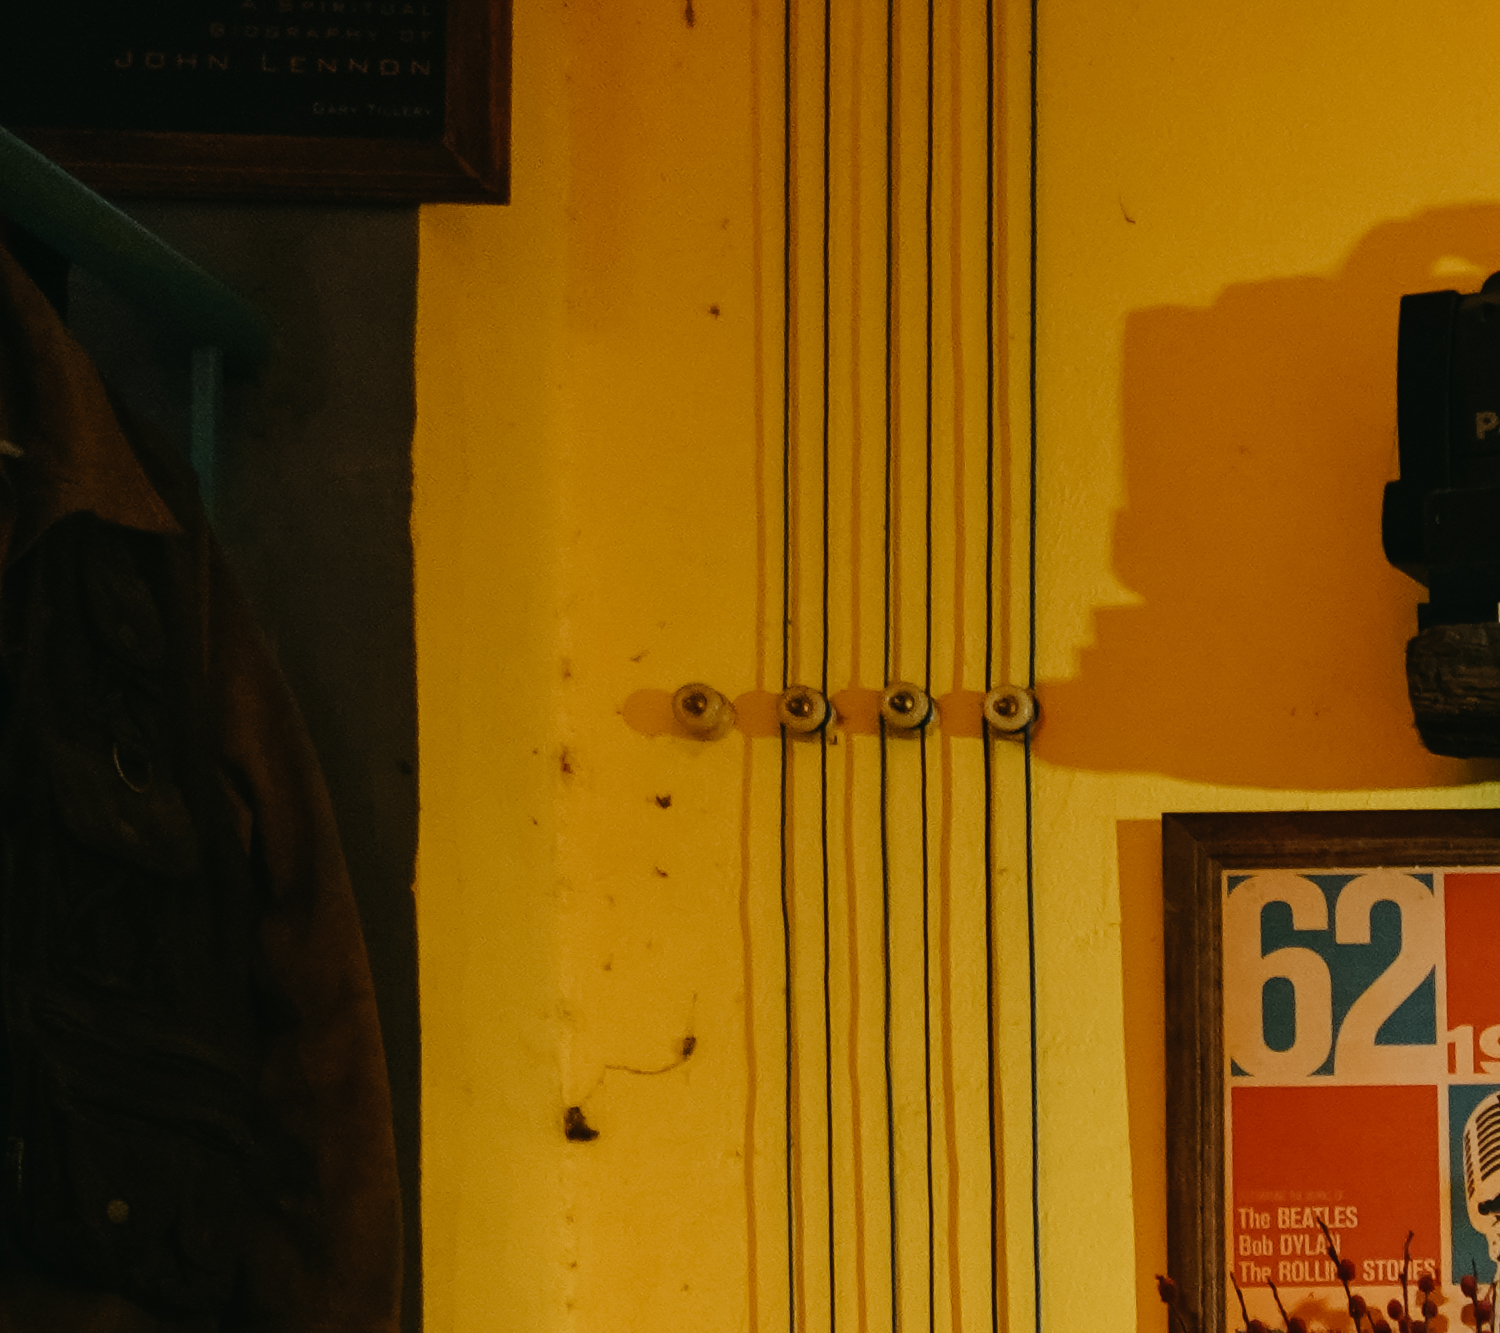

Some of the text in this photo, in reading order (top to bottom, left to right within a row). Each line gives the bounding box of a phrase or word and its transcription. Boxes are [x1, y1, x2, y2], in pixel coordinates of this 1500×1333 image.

[114, 51, 431, 76] JOHN LENNON
[1227, 871, 1436, 1078] 62
[1237, 1206, 1359, 1229] The BEATLES
[1238, 1233, 1342, 1257] Bob DYLAN
[1237, 1260, 1272, 1283] The
[1278, 1259, 1352, 1283] ROLLIN
